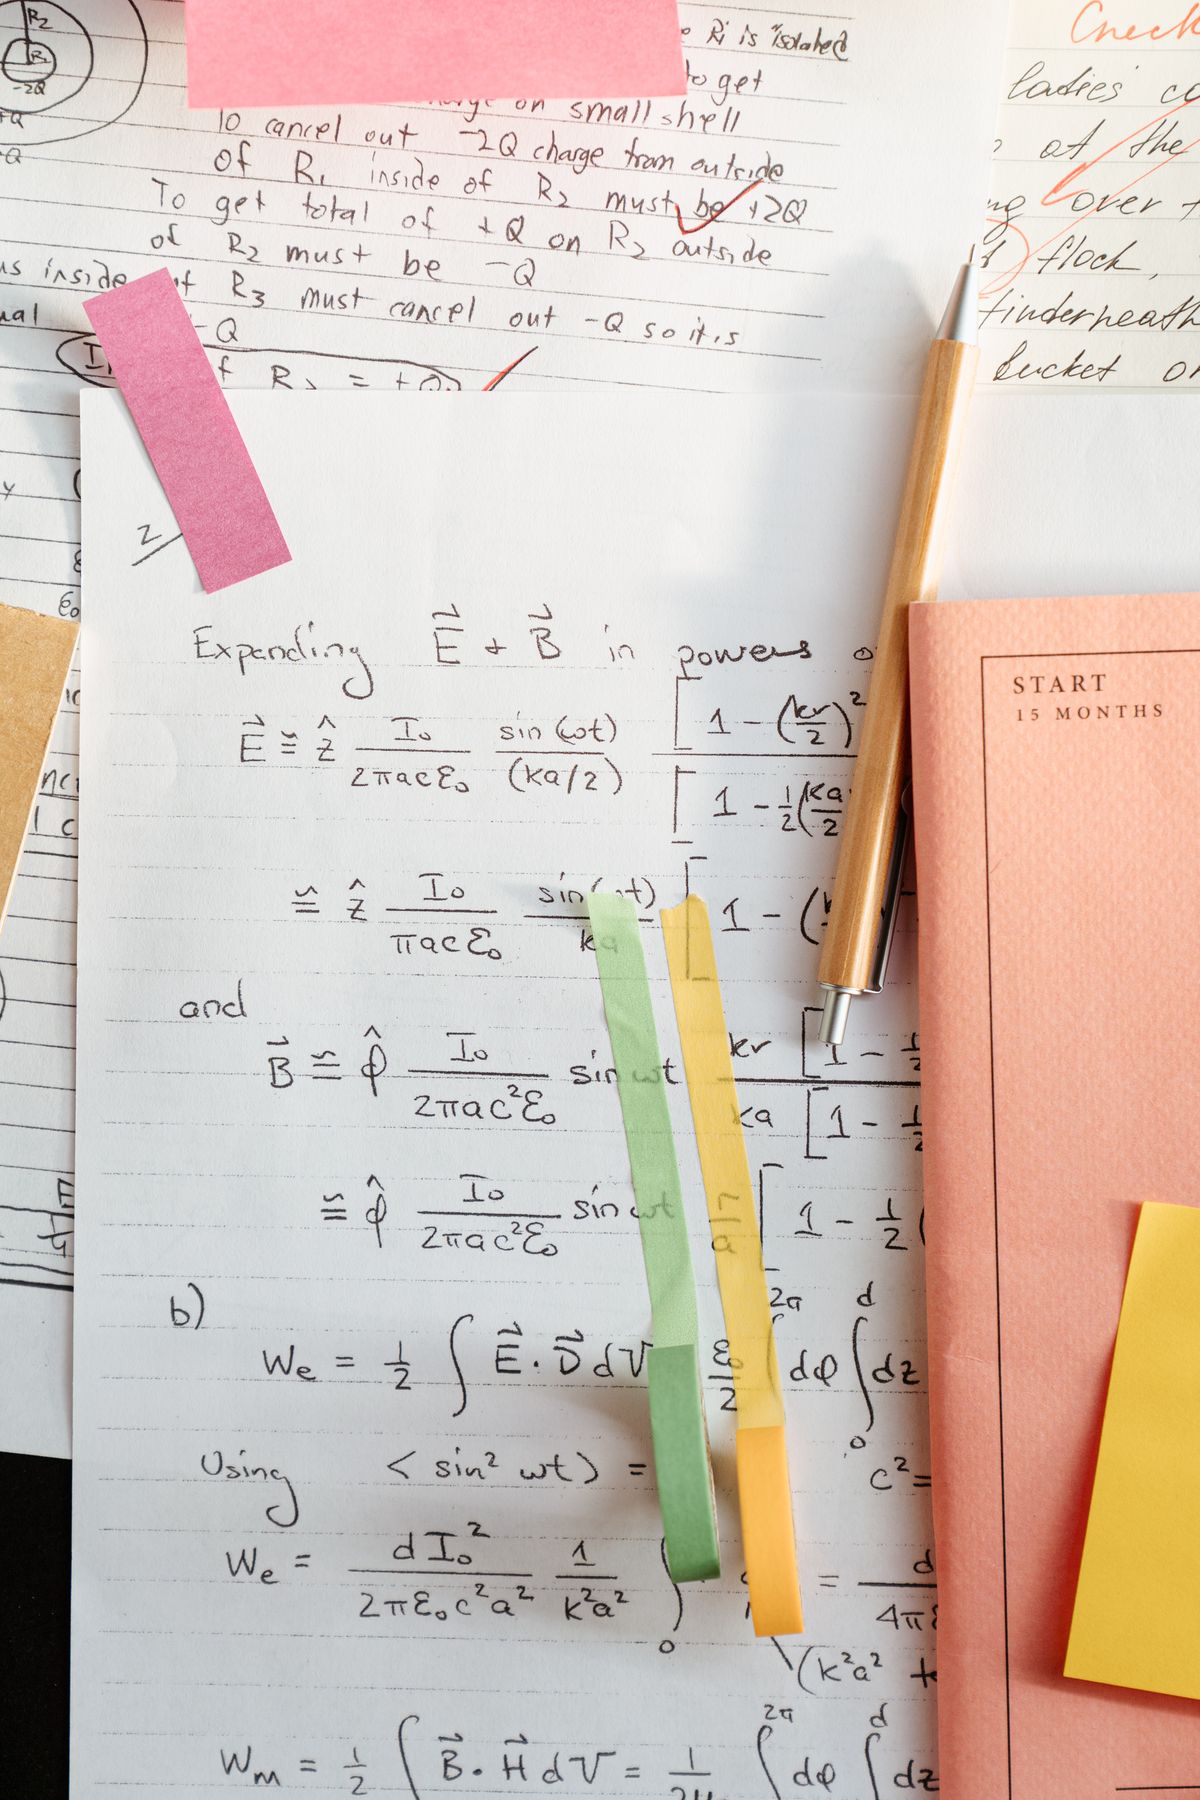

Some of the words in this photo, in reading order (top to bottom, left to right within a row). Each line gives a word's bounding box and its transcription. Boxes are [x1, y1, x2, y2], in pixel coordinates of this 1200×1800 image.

[739, 24, 759, 47] is
[711, 69, 764, 106] get
[570, 100, 651, 124] small
[661, 102, 742, 133] shell
[265, 114, 342, 143] cancel
[365, 121, 419, 148] out
[533, 130, 604, 175] charge
[691, 152, 785, 182] outside
[1040, 118, 1106, 160] at
[1129, 118, 1190, 159] the
[214, 141, 251, 176] of
[371, 151, 440, 190] inside
[463, 168, 492, 194] of
[606, 189, 676, 216] must
[695, 189, 725, 219] be
[151, 177, 185, 210] To
[210, 190, 266, 225] get
[303, 191, 368, 223] total
[401, 207, 435, 239] of
[549, 233, 581, 255] on
[672, 236, 772, 267] outside
[1071, 192, 1163, 215] over
[151, 223, 182, 250] of
[286, 243, 372, 266] must
[403, 249, 441, 282] be
[44, 257, 128, 289] inside
[173, 269, 196, 296] f
[301, 286, 379, 312] must
[389, 296, 475, 325] cancel
[509, 305, 557, 329] out
[643, 320, 676, 340] so
[193, 620, 374, 700] Expanding
[604, 624, 635, 662] in
[677, 640, 813, 680] powers
[1013, 673, 1107, 695] START
[500, 711, 541, 740] sin
[1016, 708, 1039, 722] 15
[1055, 703, 1163, 721] MONTHS
[179, 978, 247, 1019] and
[569, 1049, 618, 1085] sin
[573, 1184, 619, 1220] sin
[170, 1282, 205, 1330] b)
[201, 1449, 299, 1528] Using
